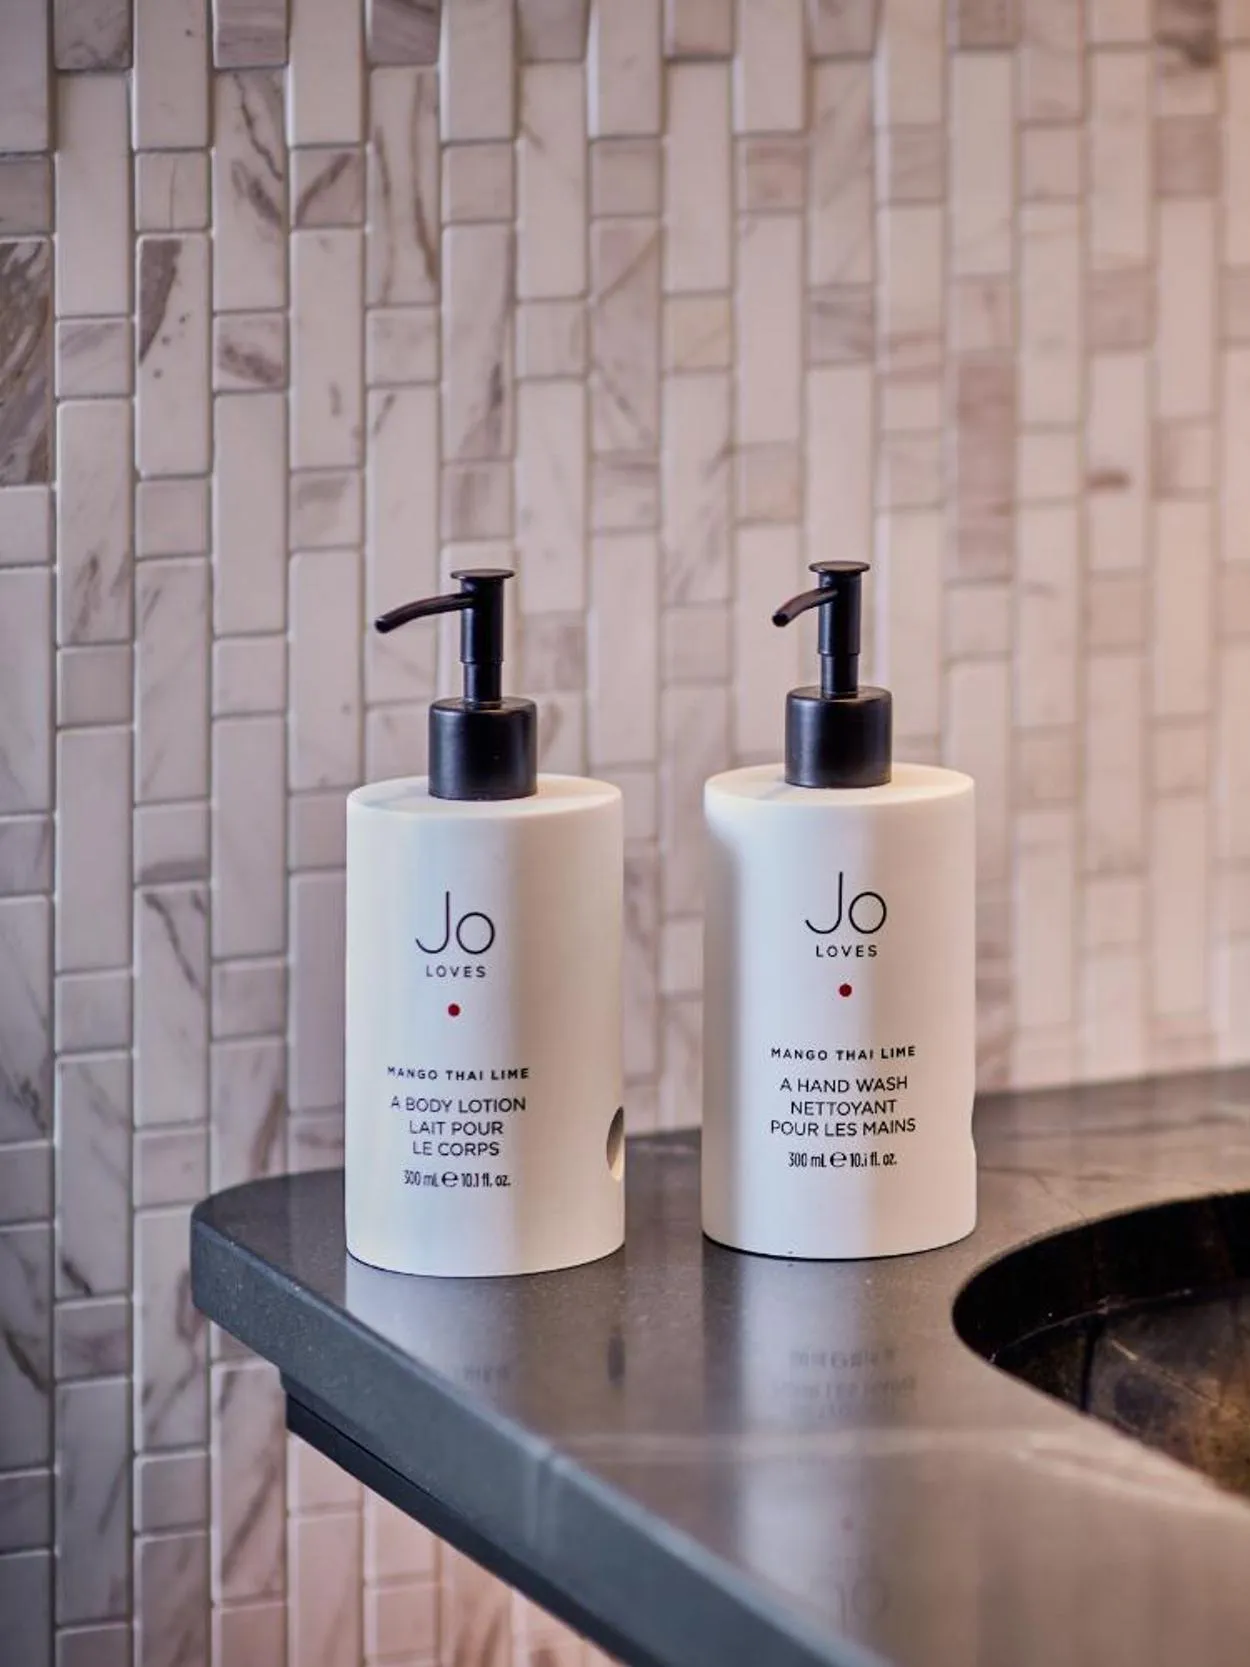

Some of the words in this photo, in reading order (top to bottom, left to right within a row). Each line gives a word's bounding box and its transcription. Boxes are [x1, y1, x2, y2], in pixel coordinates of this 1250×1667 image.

[805, 871, 887, 934] Jo
[415, 891, 495, 955] Jo
[816, 945, 878, 957] LOVES
[425, 965, 487, 978] LOVES
[771, 1048, 828, 1061] MANGO
[836, 1049, 874, 1061] THAI
[881, 1045, 916, 1059] LIME
[387, 1067, 438, 1080] MANGO
[445, 1070, 484, 1080] THAI
[491, 1068, 530, 1080] LIME
[780, 1077, 793, 1092] A
[797, 1079, 850, 1094] HAND
[856, 1076, 908, 1093] WASH
[391, 1095, 401, 1109] A
[406, 1097, 452, 1113] BODY
[458, 1097, 526, 1113] LOTION
[790, 1100, 897, 1117] NETTOYANT
[409, 1120, 446, 1136] LAIT
[451, 1121, 503, 1136] POUR
[771, 1119, 819, 1137] POUR
[824, 1121, 857, 1137] LES
[863, 1118, 916, 1135] MAINS
[413, 1142, 433, 1155] LE
[437, 1142, 500, 1157] CORPS
